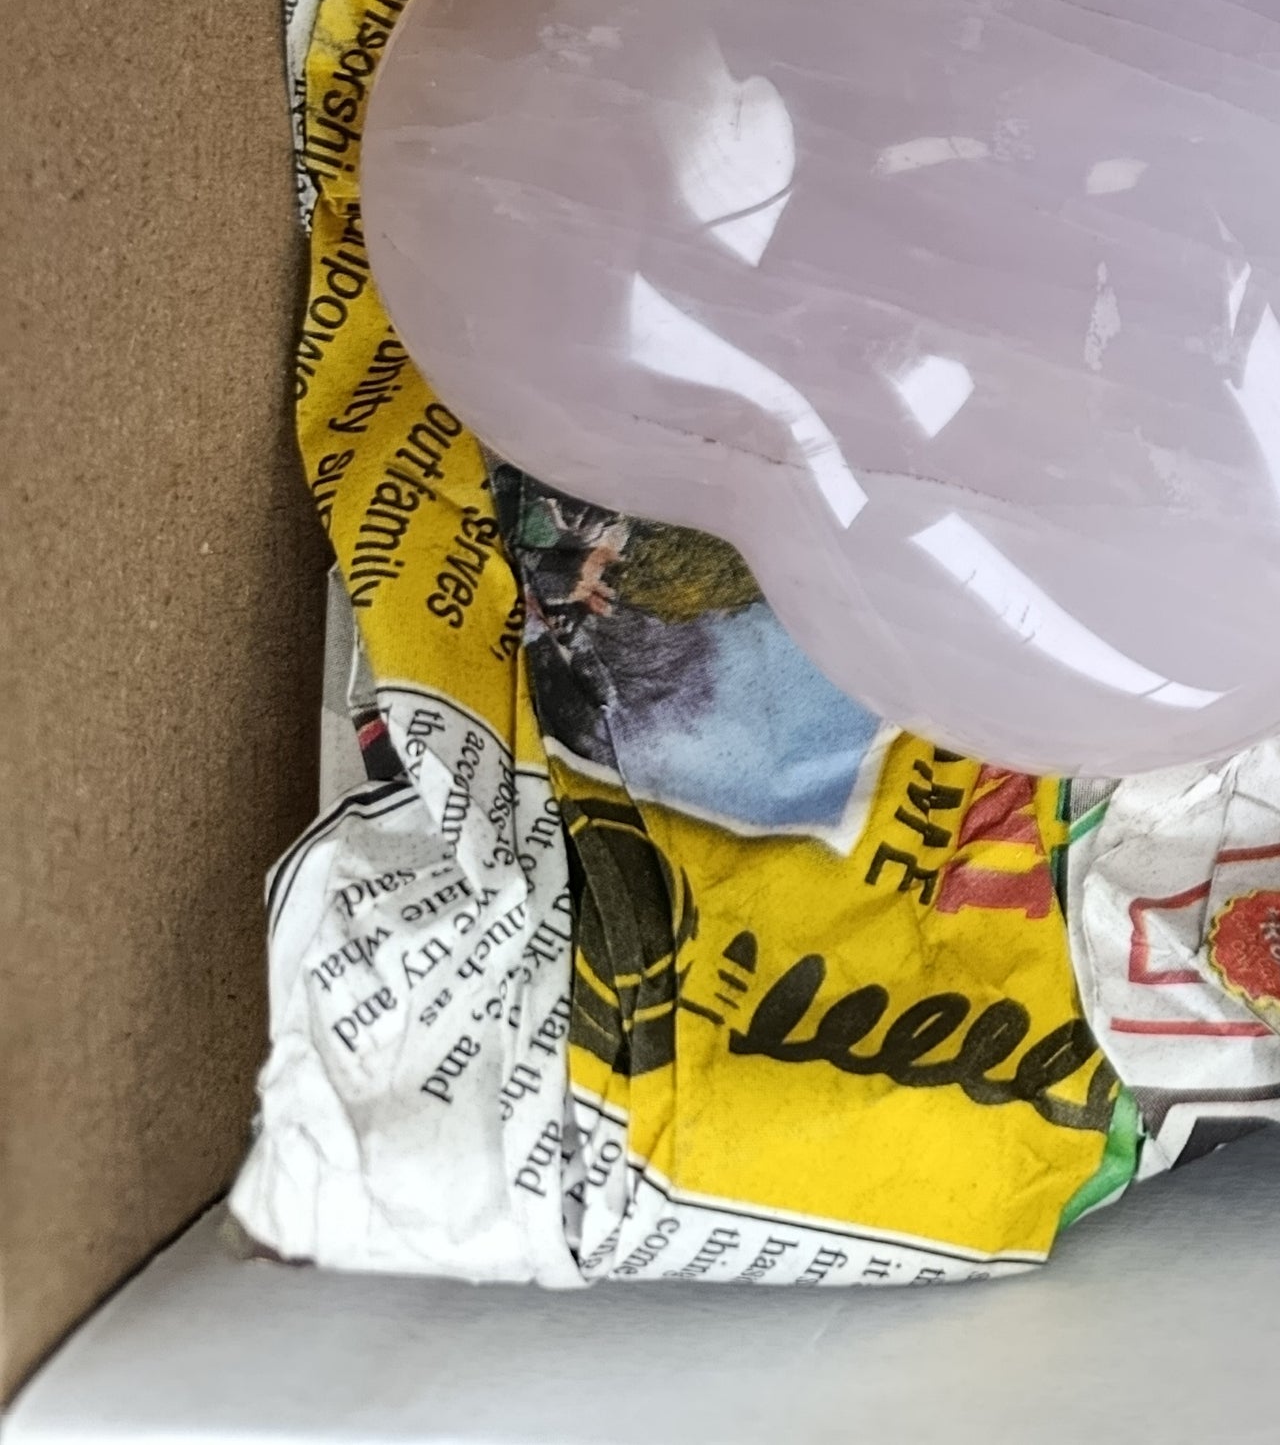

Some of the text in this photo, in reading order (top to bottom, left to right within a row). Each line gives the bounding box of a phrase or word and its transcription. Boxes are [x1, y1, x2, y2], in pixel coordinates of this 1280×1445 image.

[309, 923, 395, 994] what
[329, 932, 455, 1056] try and
[420, 1032, 484, 1106] and
[513, 1117, 564, 1200] and
